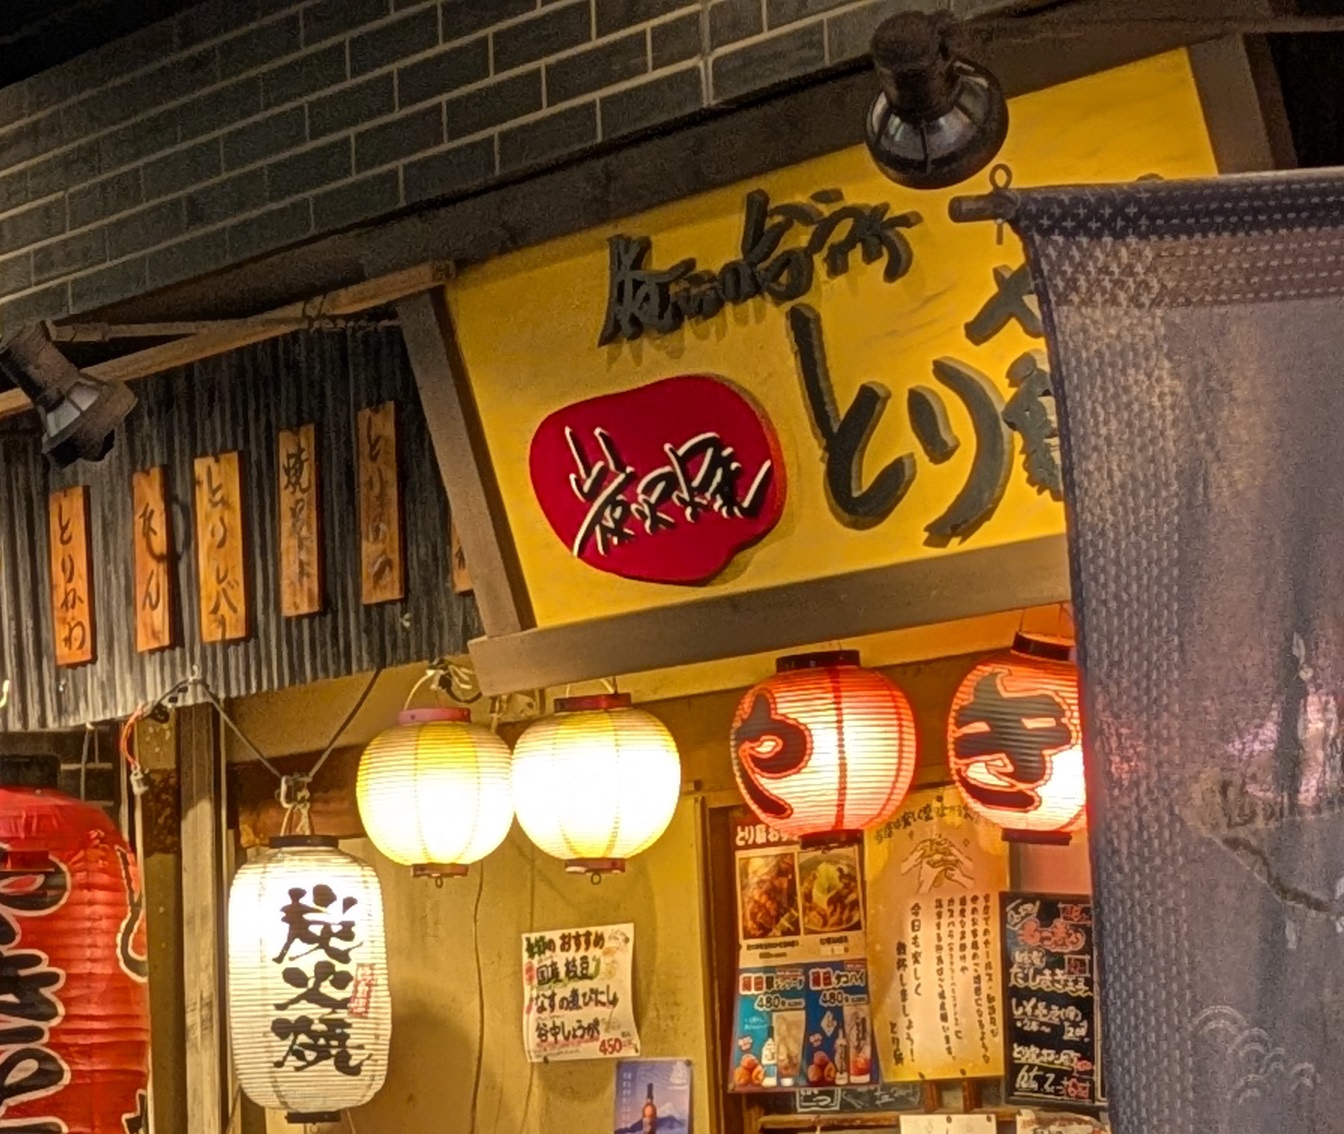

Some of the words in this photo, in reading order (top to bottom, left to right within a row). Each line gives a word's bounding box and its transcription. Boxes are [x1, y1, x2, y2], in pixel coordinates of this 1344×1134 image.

[57, 503, 87, 652] とりかわ
[269, 883, 374, 1077] 炭火焼
[559, 929, 606, 953] おすすめ
[598, 1038, 623, 1056] 450
